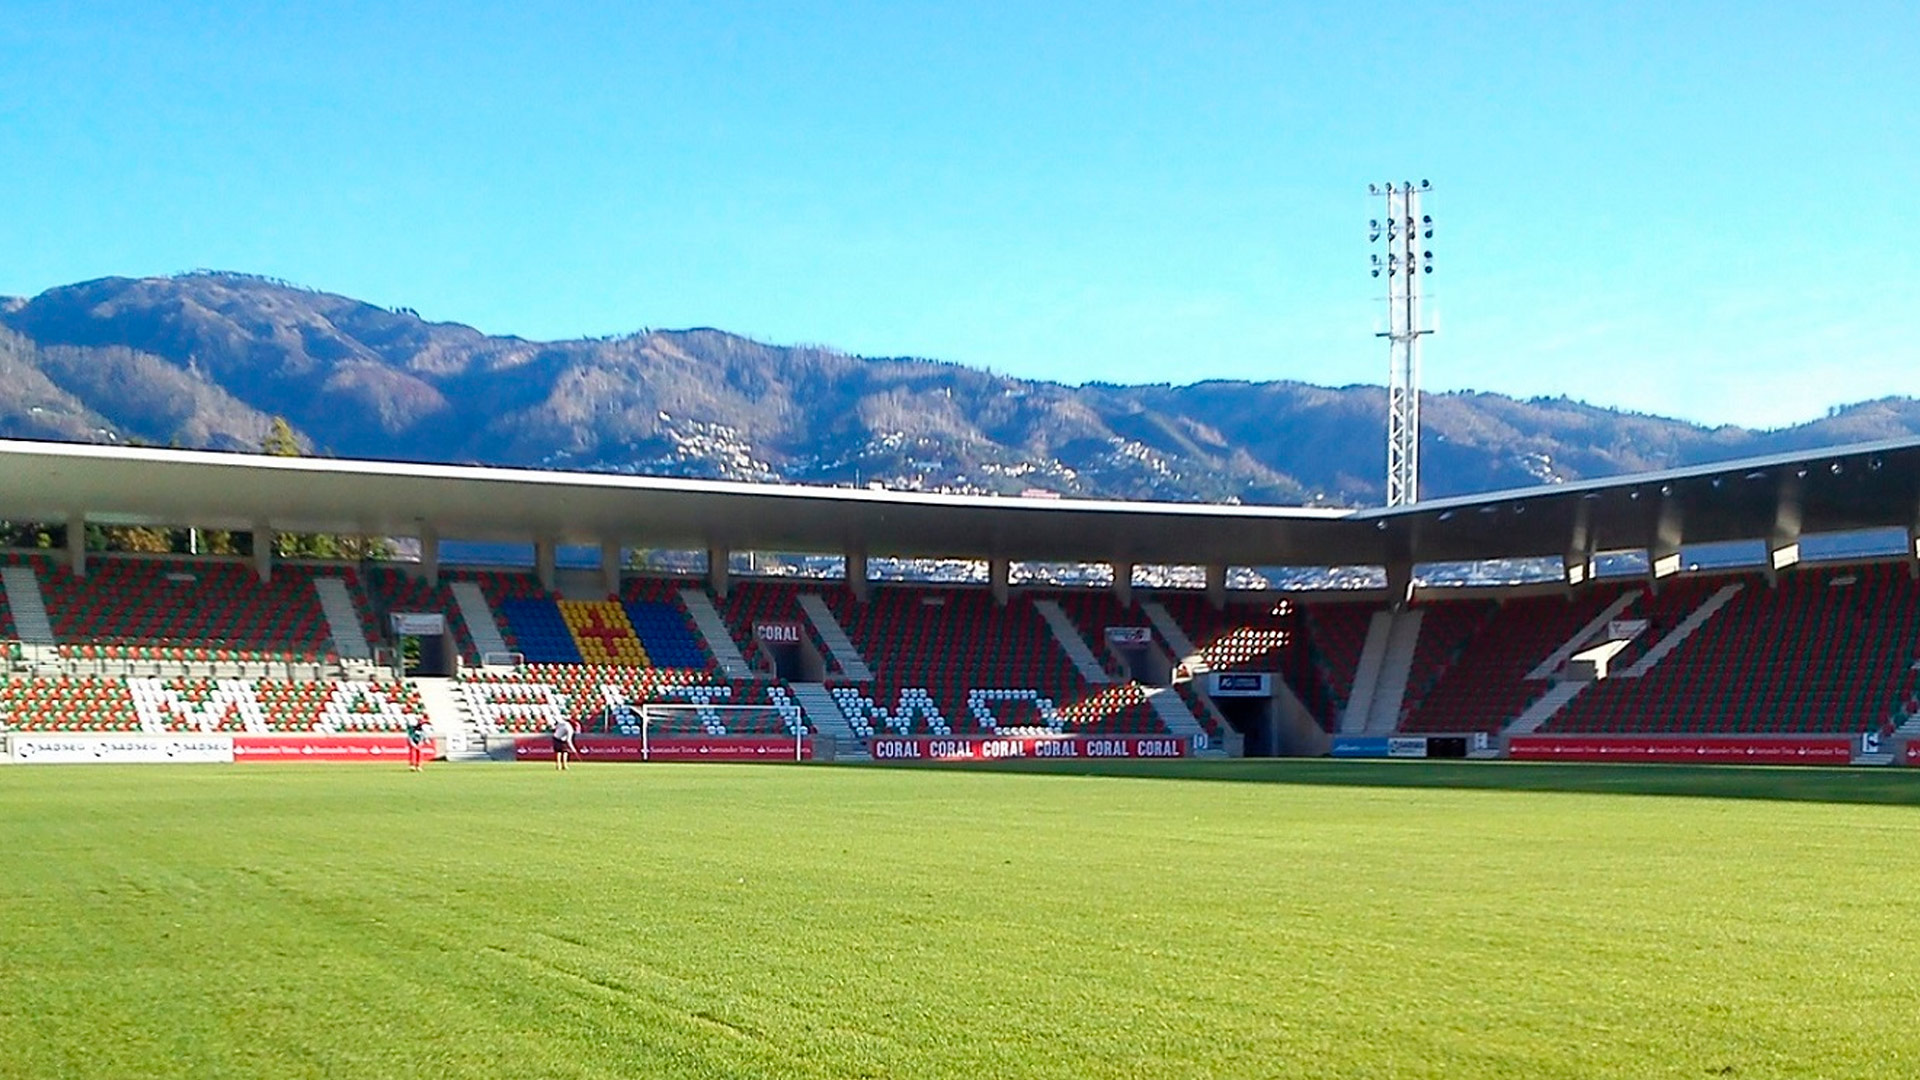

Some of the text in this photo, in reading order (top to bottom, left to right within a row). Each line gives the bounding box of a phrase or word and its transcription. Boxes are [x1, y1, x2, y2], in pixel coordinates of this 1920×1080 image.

[757, 625, 799, 641] CORAL
[876, 740, 1180, 757] CORAL CORAL CORAL CORAL CORAL CORAL
